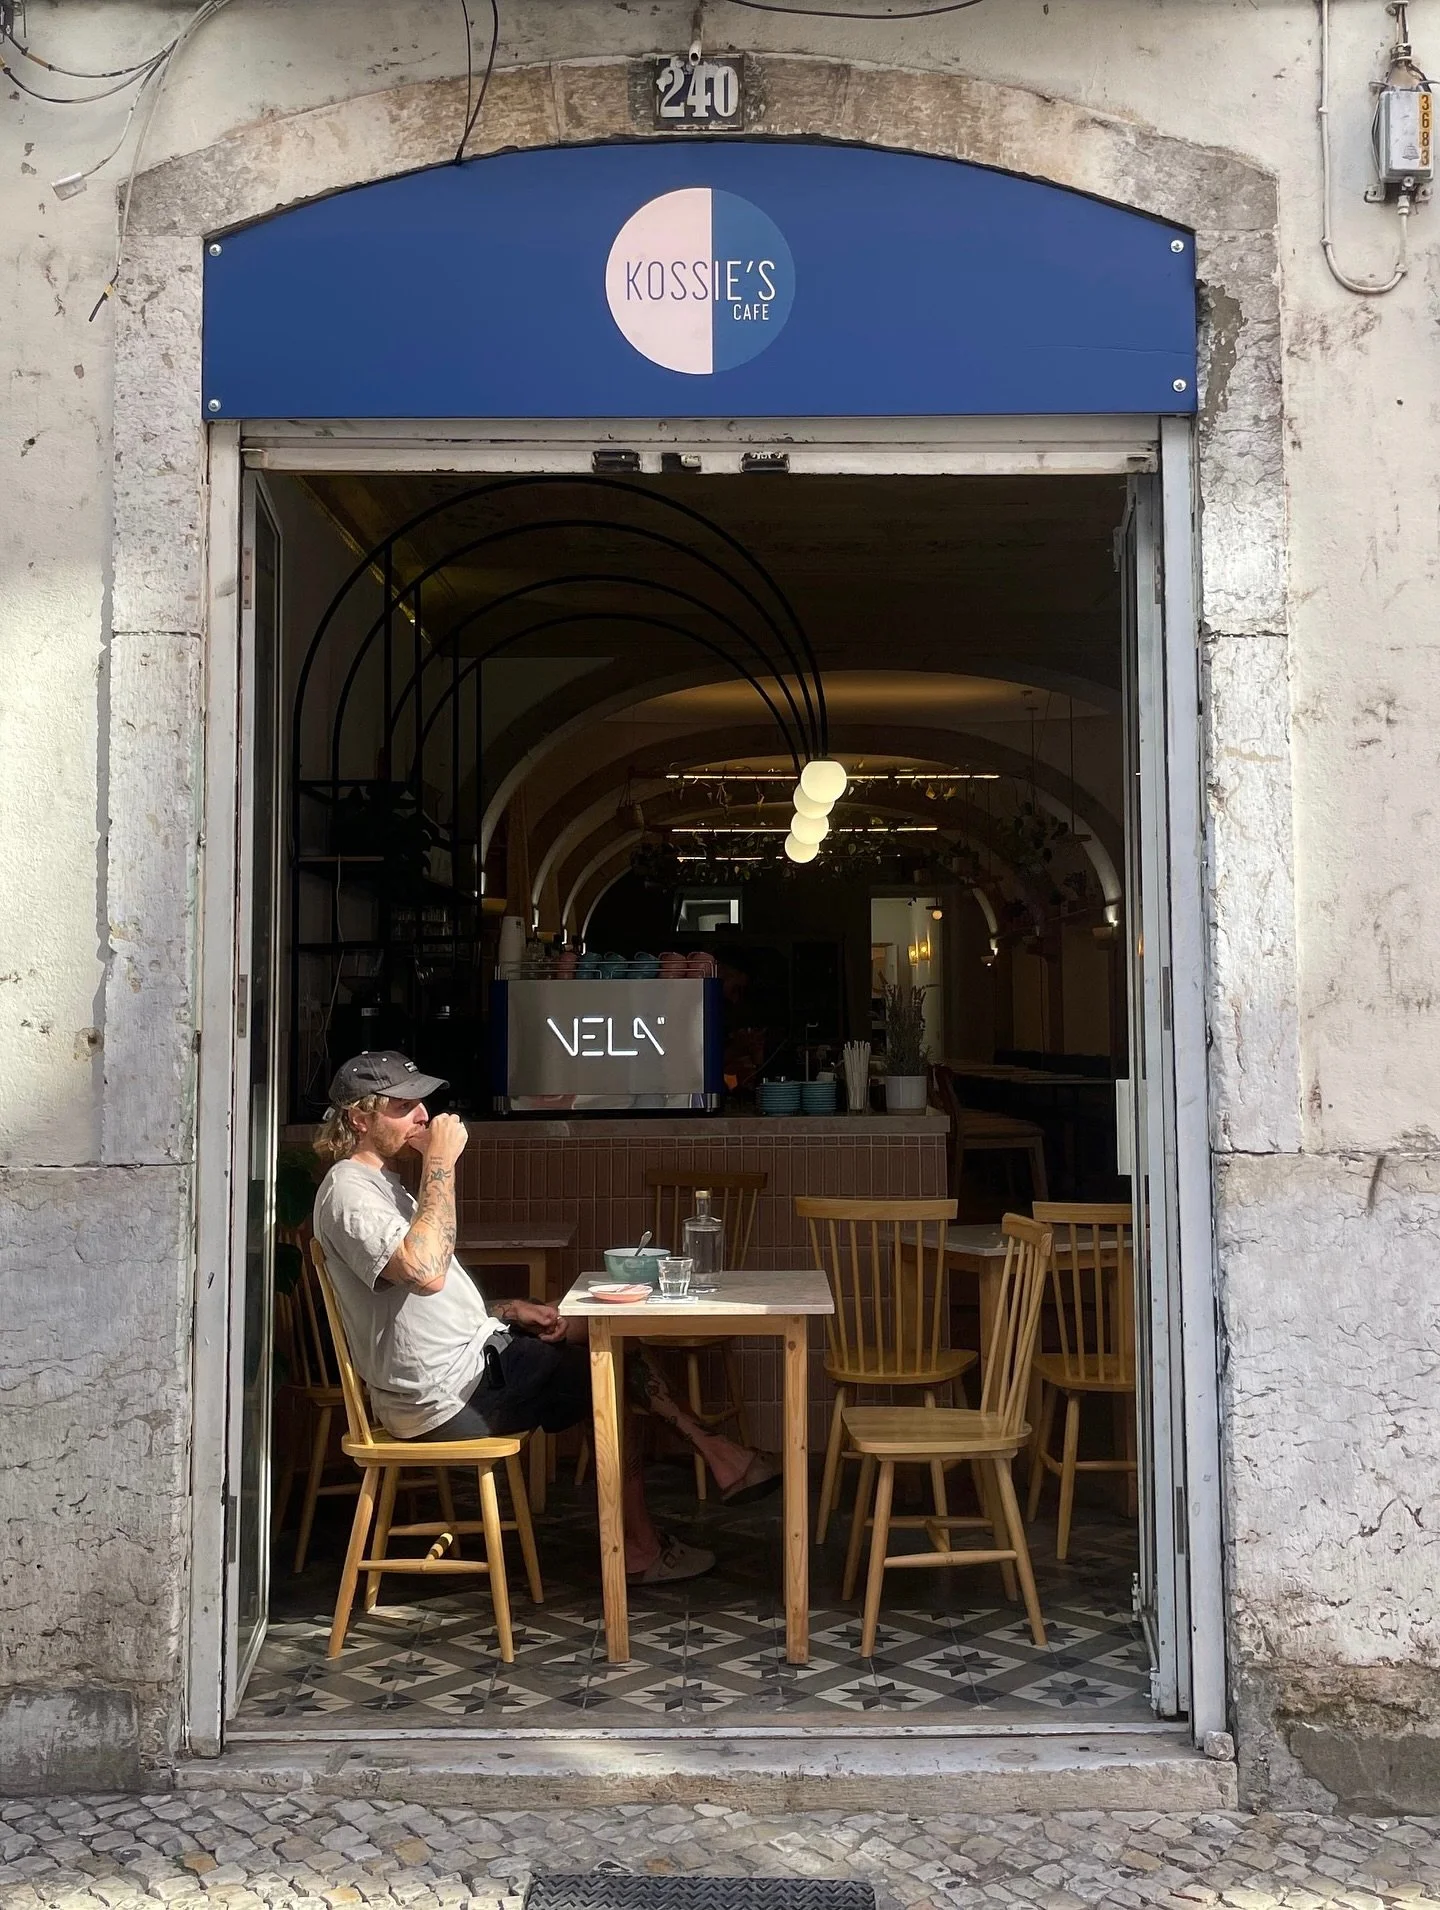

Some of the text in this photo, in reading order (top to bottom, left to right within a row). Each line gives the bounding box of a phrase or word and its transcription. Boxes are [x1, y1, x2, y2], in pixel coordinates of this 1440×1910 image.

[656, 65, 739, 118] 240
[1421, 94, 1430, 166] 3683
[626, 260, 776, 301] KOSSIE'S
[733, 303, 769, 320] CAFE
[546, 1017, 665, 1056] VELA
